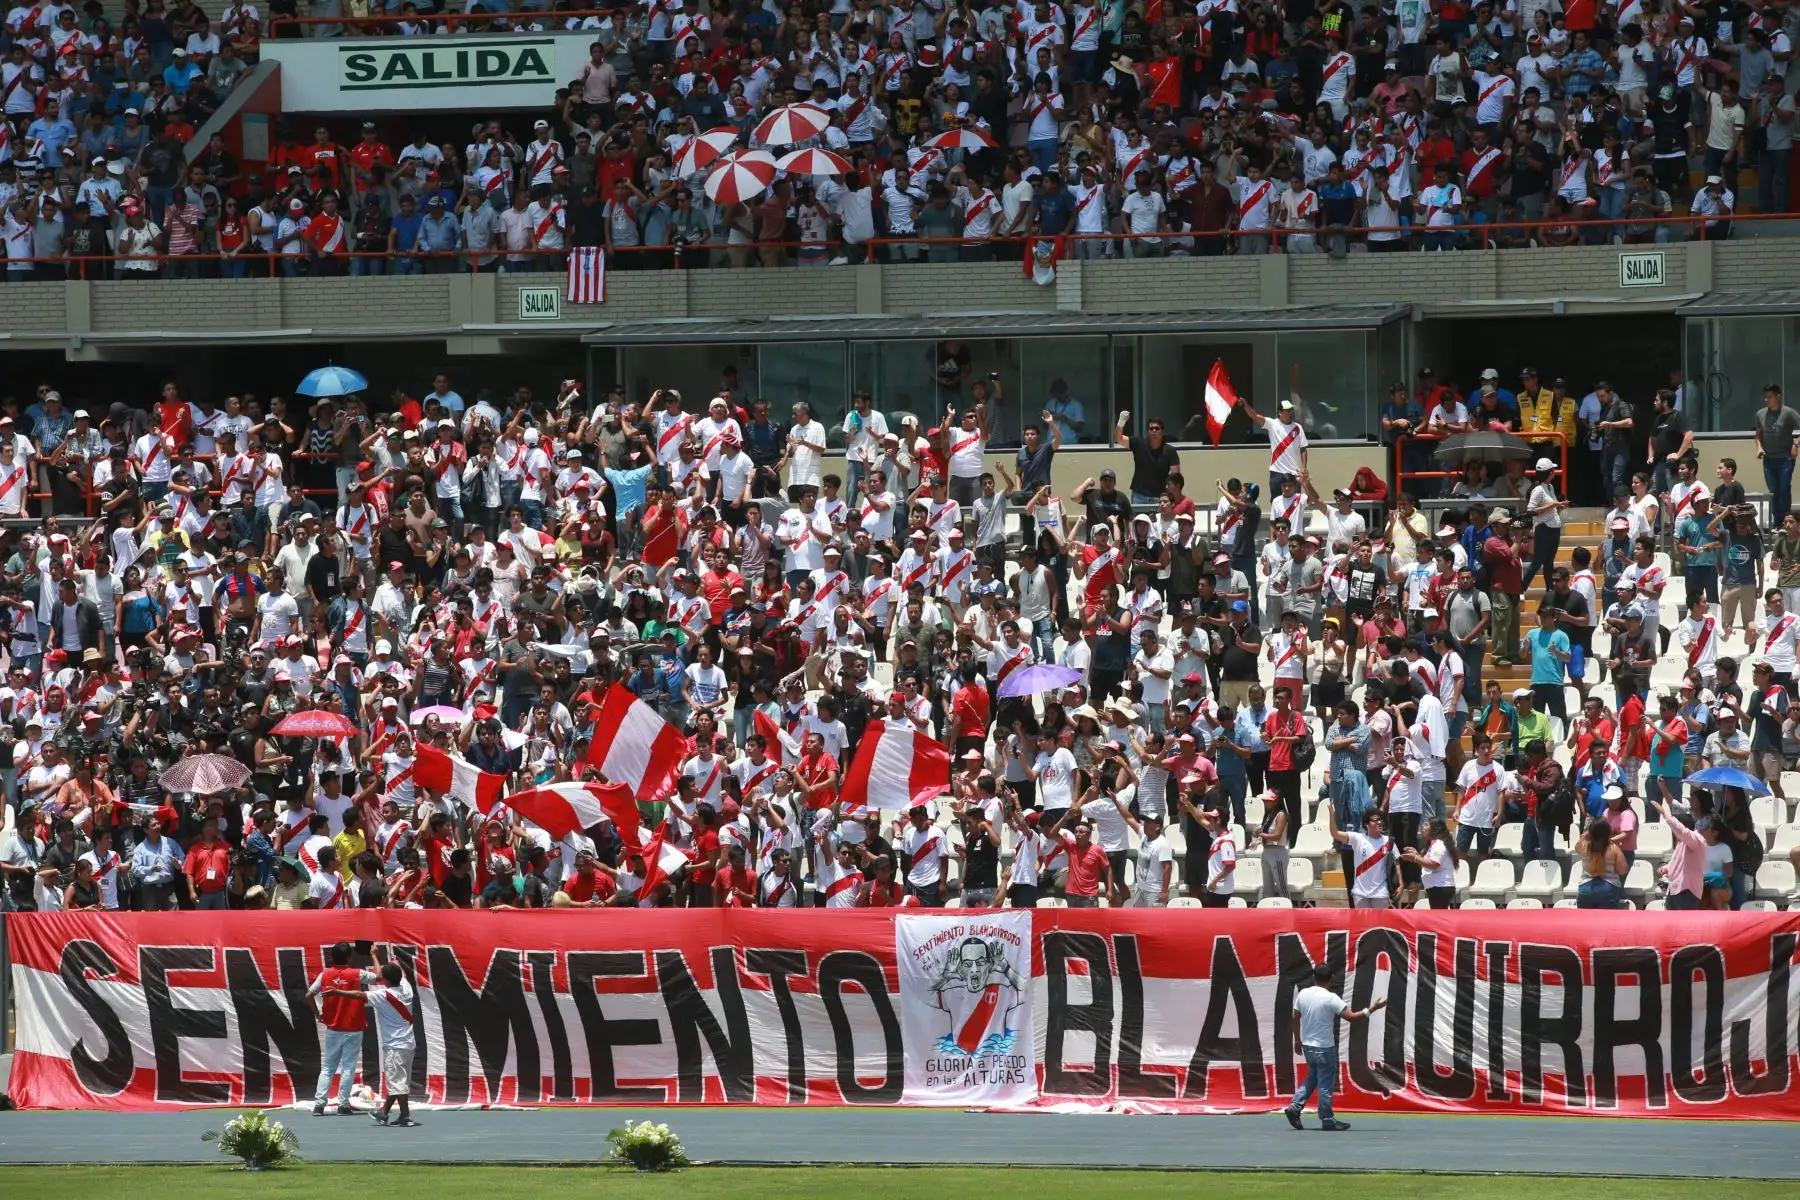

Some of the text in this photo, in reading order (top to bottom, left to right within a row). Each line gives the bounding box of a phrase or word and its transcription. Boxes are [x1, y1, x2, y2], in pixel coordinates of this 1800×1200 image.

[344, 48, 550, 82] SALIDA
[1626, 259, 1659, 280] SALIDA
[525, 293, 555, 313] SALIDA
[913, 925, 965, 961] SENTIMIENTO
[1040, 926, 1800, 1110] BLANQUIRROJ
[926, 1058, 974, 1073] GLORIA
[978, 1060, 985, 1069] a
[926, 1069, 1025, 1087] en las ALTURAS
